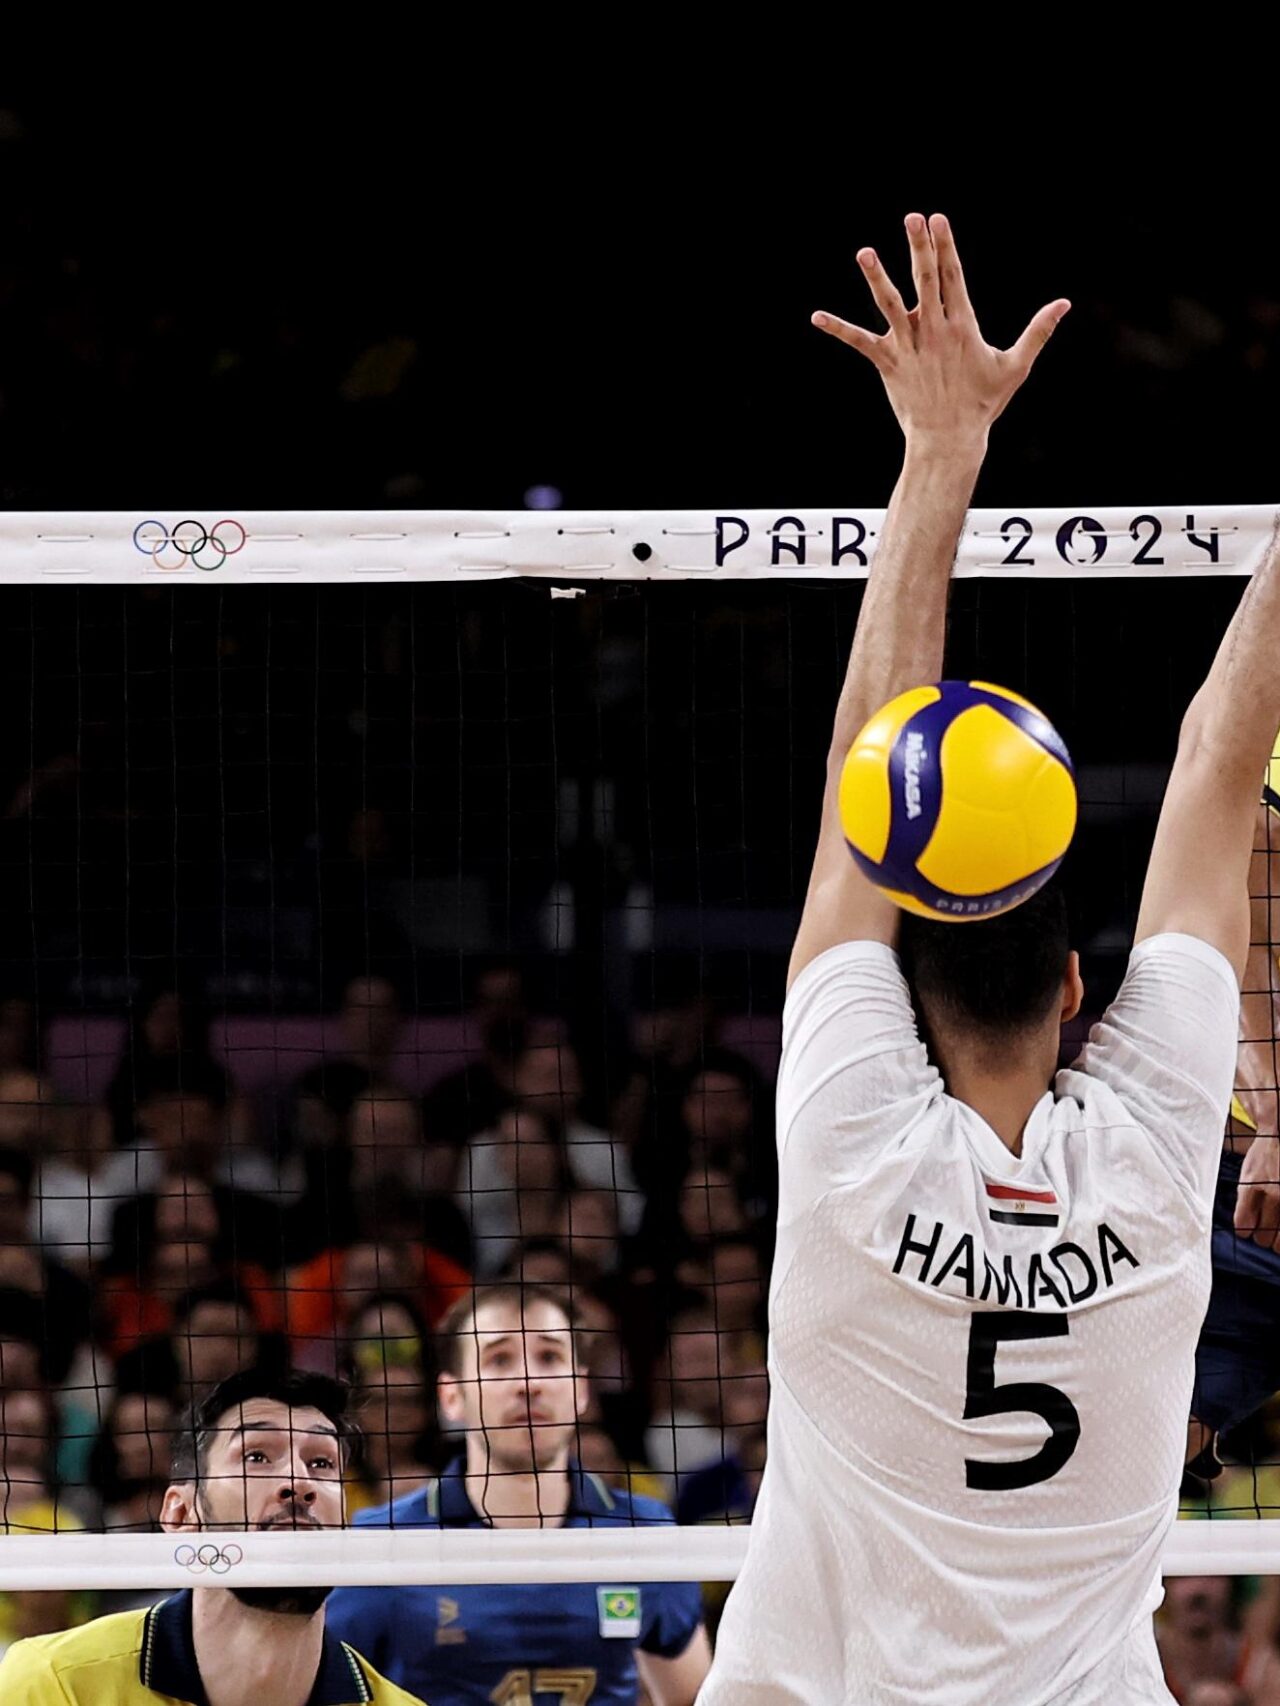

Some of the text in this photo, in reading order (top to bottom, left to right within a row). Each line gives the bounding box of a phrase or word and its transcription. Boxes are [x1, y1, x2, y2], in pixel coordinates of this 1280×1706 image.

[715, 514, 1219, 567] PAR 2024
[892, 1213, 1140, 1309] HAMADA
[962, 1310, 1081, 1491] 5
